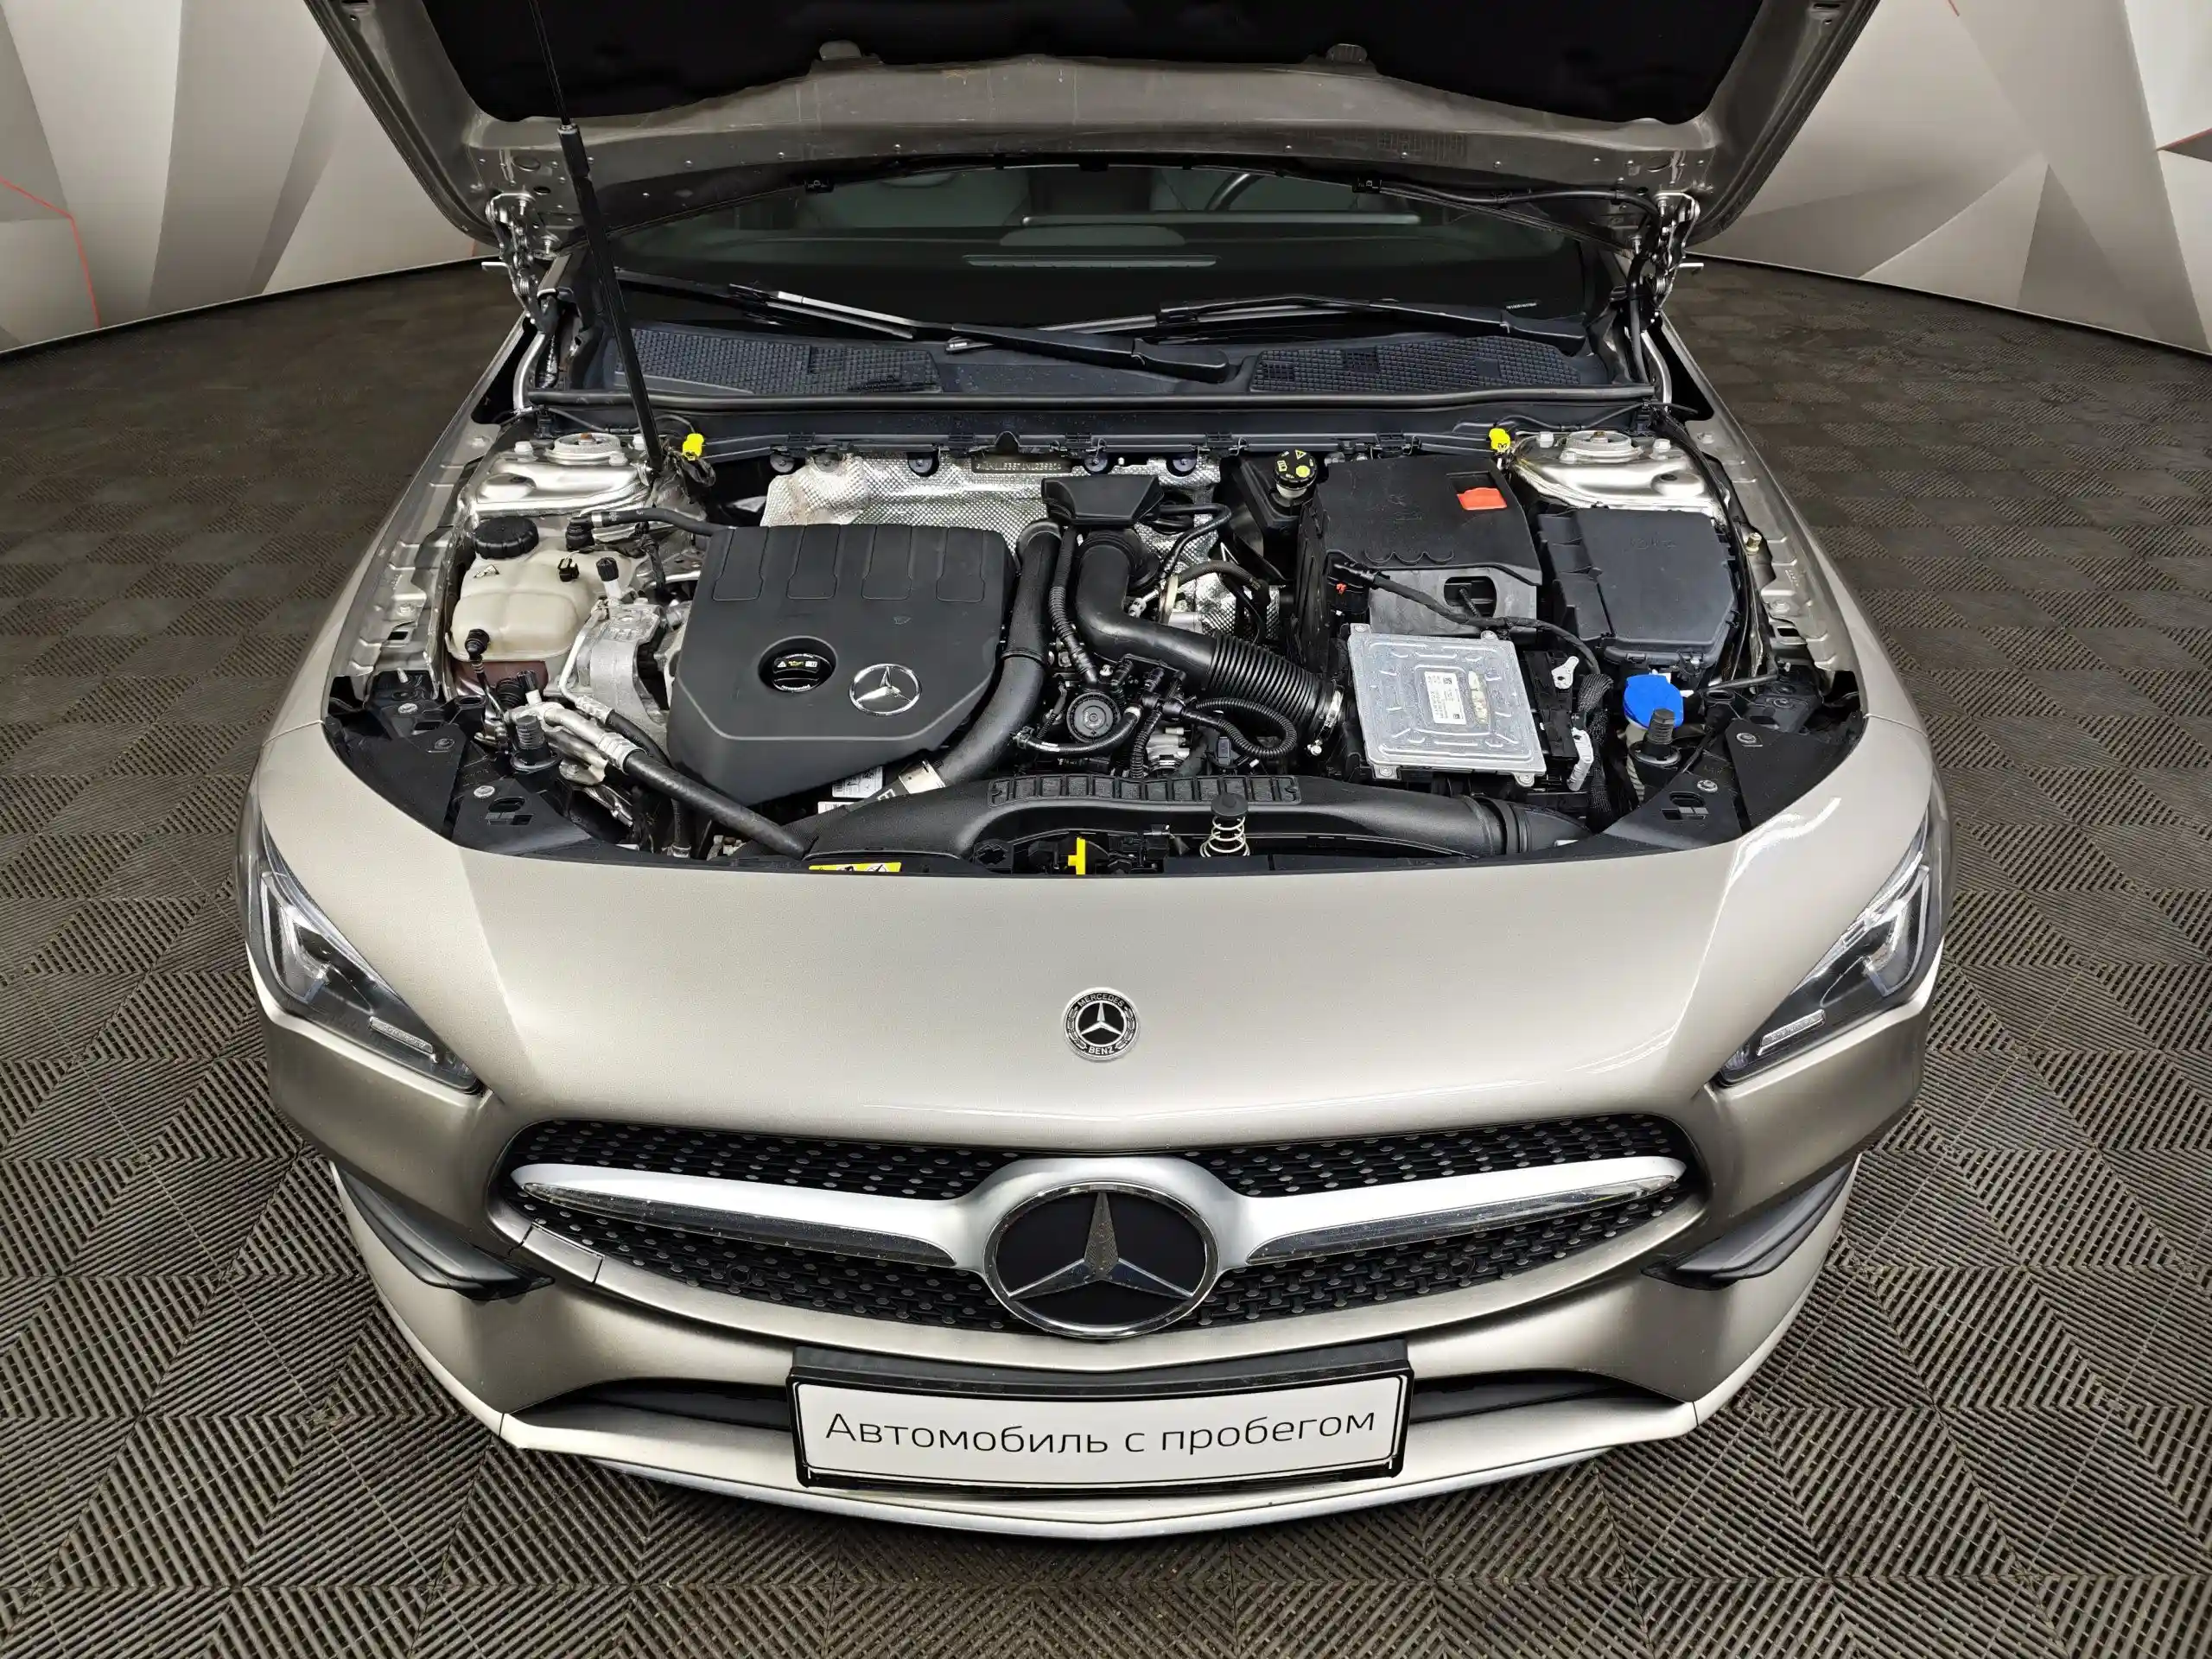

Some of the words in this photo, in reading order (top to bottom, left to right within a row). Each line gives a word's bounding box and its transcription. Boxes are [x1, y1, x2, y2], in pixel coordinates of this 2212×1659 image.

[1078, 993, 1125, 1007] MERCEDES
[1089, 1046, 1115, 1055] BENZ
[825, 1412, 1109, 1455] Автомобиль
[1125, 1433, 1145, 1452] с
[1162, 1411, 1376, 1456] пробегом
